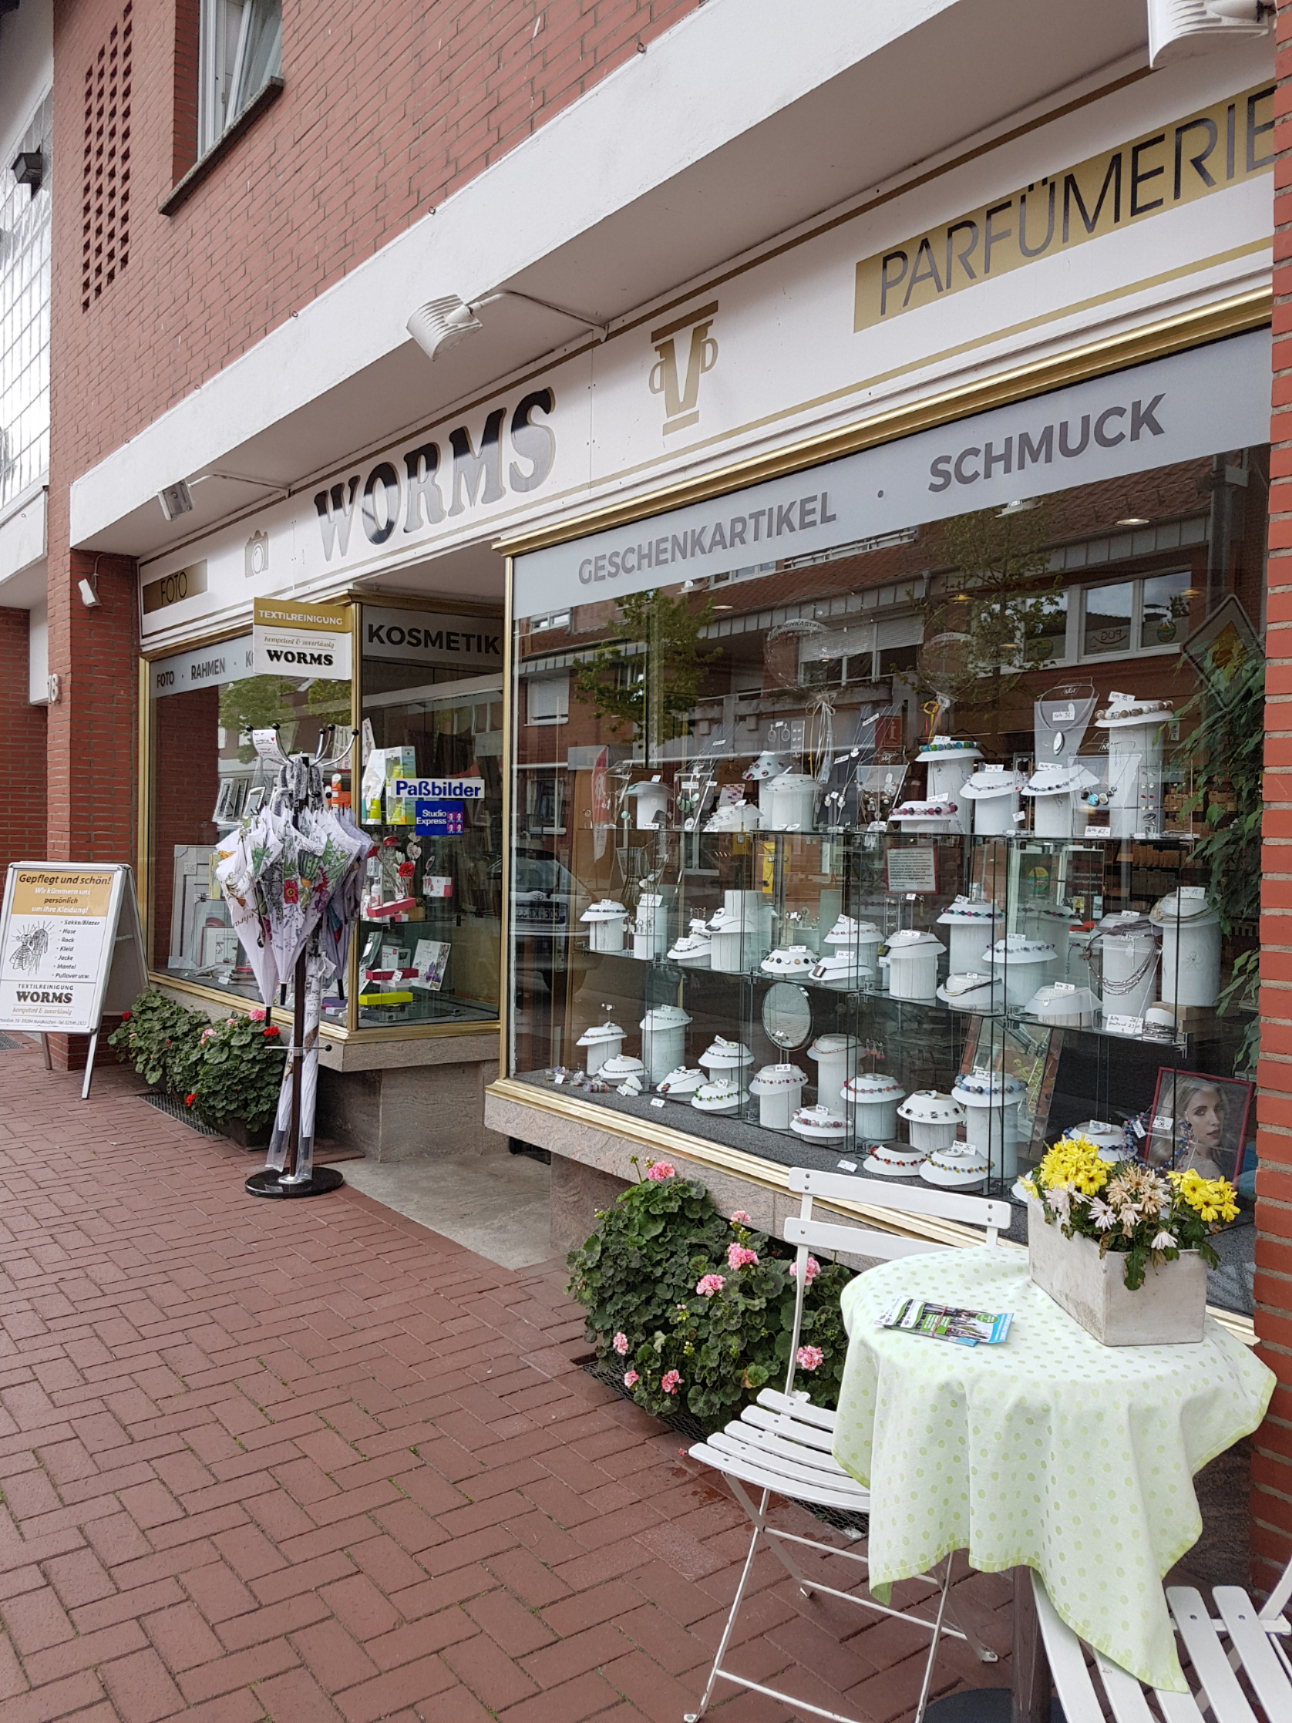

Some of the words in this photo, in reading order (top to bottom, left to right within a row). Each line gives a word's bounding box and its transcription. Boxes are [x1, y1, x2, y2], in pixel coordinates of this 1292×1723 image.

[880, 84, 1275, 317] PARFÜMERIE
[313, 386, 557, 562] WORMS
[578, 490, 837, 585] GESCHENKARTIKEL
[927, 392, 1167, 493] SCHMUCK
[160, 571, 188, 606] FOTO
[258, 609, 344, 626] TEXTILREINIGUNG
[367, 623, 501, 655] KOSMETIK
[266, 649, 334, 667] WORMS
[156, 670, 175, 689] FOTO
[191, 657, 226, 681] RAHMEN
[396, 780, 482, 797] Paßbilder
[416, 816, 447, 827] Express
[422, 809, 447, 818] Studio
[19, 873, 59, 886] Gepflegt
[60, 875, 80, 885] und
[80, 875, 112, 885] schön!
[44, 896, 79, 904] persönlich
[16, 991, 73, 1004] WORMS
